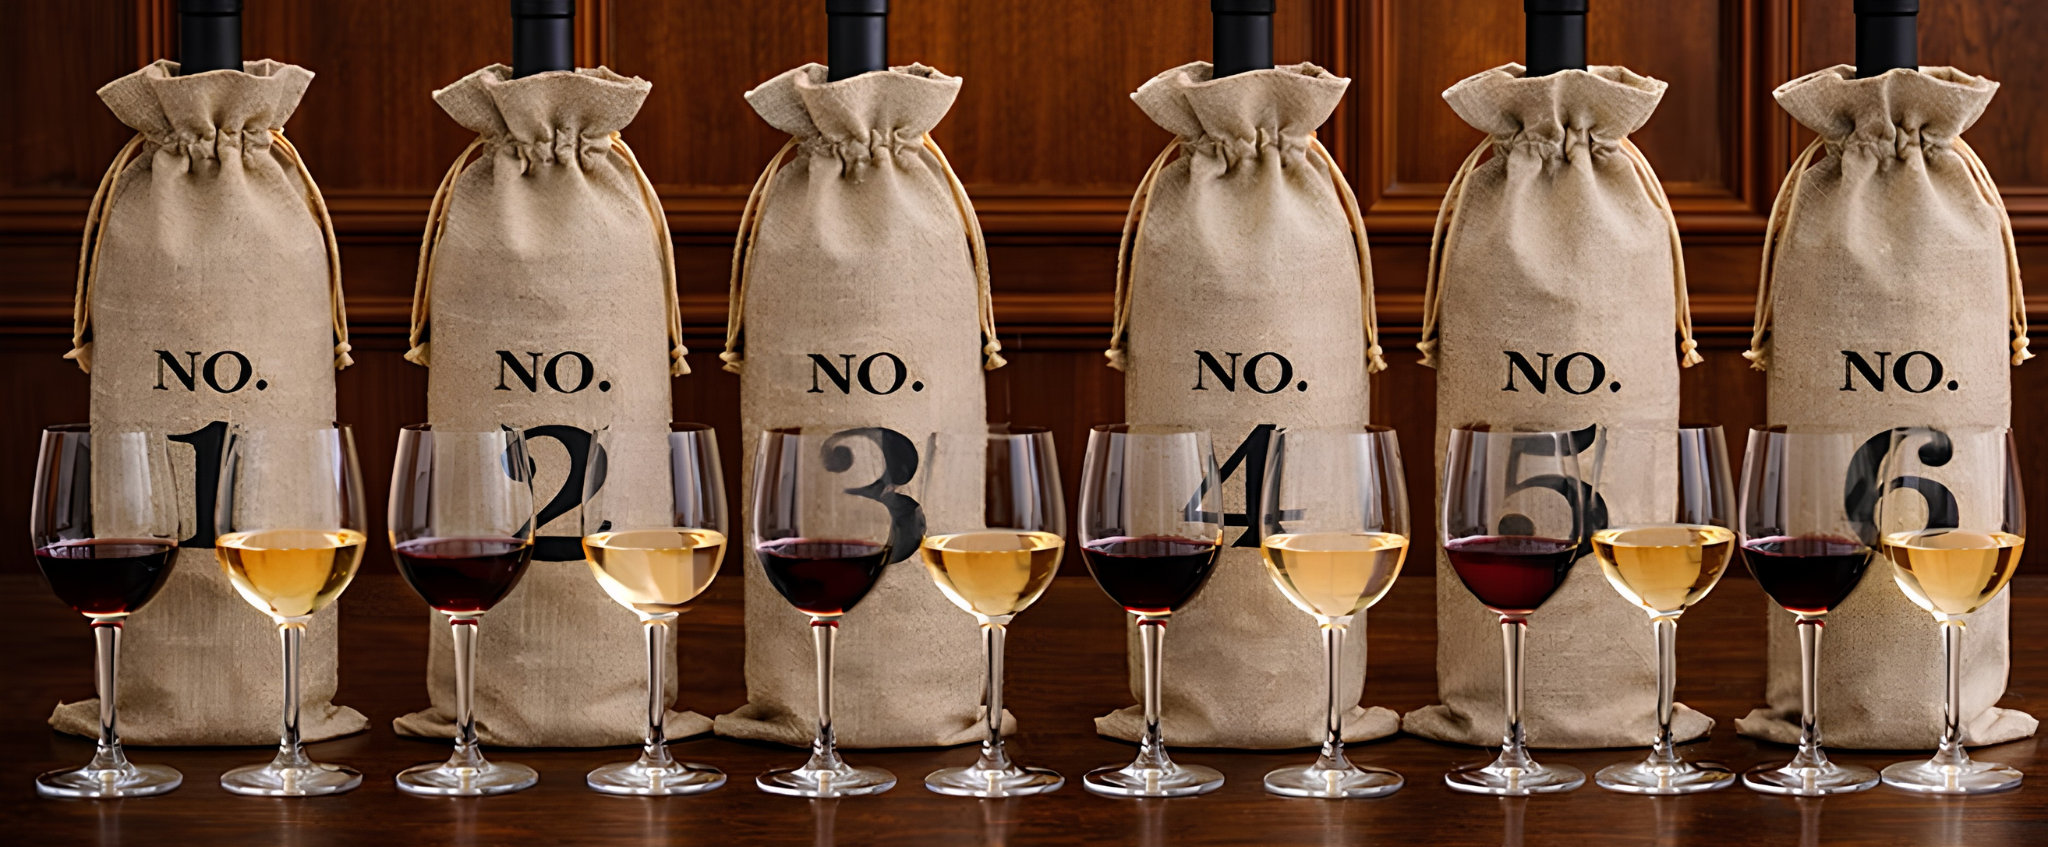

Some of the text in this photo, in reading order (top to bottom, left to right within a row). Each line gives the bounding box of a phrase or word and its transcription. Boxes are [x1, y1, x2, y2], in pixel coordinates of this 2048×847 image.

[152, 349, 268, 394] NO.
[493, 350, 612, 394] NO.
[806, 351, 924, 396] NO.
[1191, 349, 1308, 395] NO.
[1501, 350, 1622, 396] NO.
[1839, 350, 1959, 394] NO.
[167, 420, 240, 548] 1
[499, 424, 612, 562] 2
[819, 426, 926, 564] 3
[1182, 423, 1306, 549] 4
[1497, 423, 1609, 557] 5
[1844, 426, 1960, 554] 6
